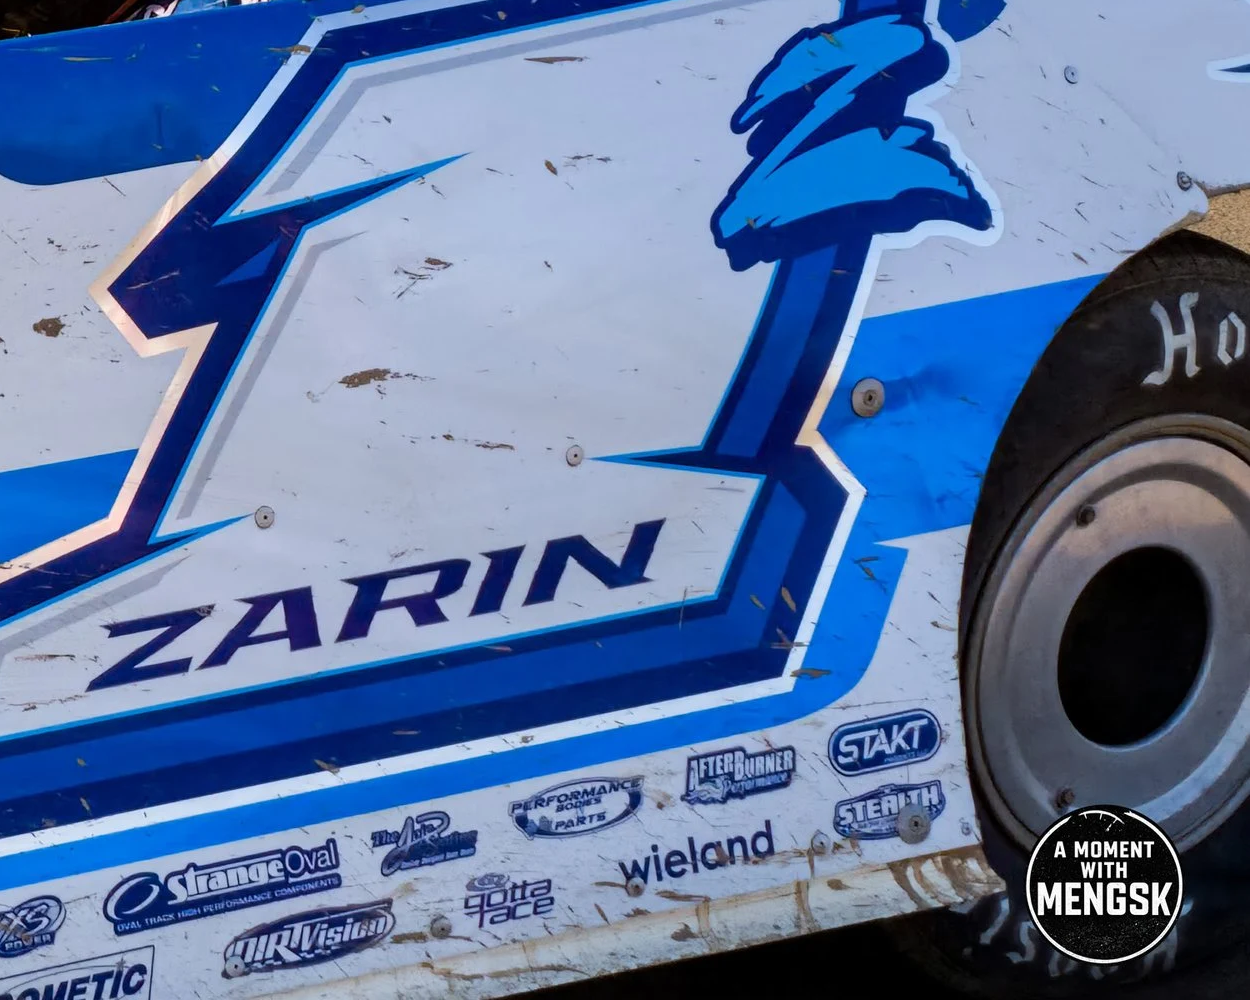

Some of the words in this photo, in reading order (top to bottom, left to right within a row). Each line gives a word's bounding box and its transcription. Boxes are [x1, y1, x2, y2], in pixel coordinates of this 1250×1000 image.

[84, 518, 666, 692] ZARIN
[837, 718, 929, 764] STAKT
[511, 779, 641, 814] PERFORMANCE
[555, 796, 602, 813] BODIES
[554, 811, 607, 831] PARTS
[618, 820, 775, 885] wieland
[117, 918, 143, 933] OVAL
[145, 911, 176, 927] TRACK
[178, 905, 202, 919] HIGH
[203, 891, 272, 914] PERFORMANCE
[275, 876, 340, 899] COMPONENTS
